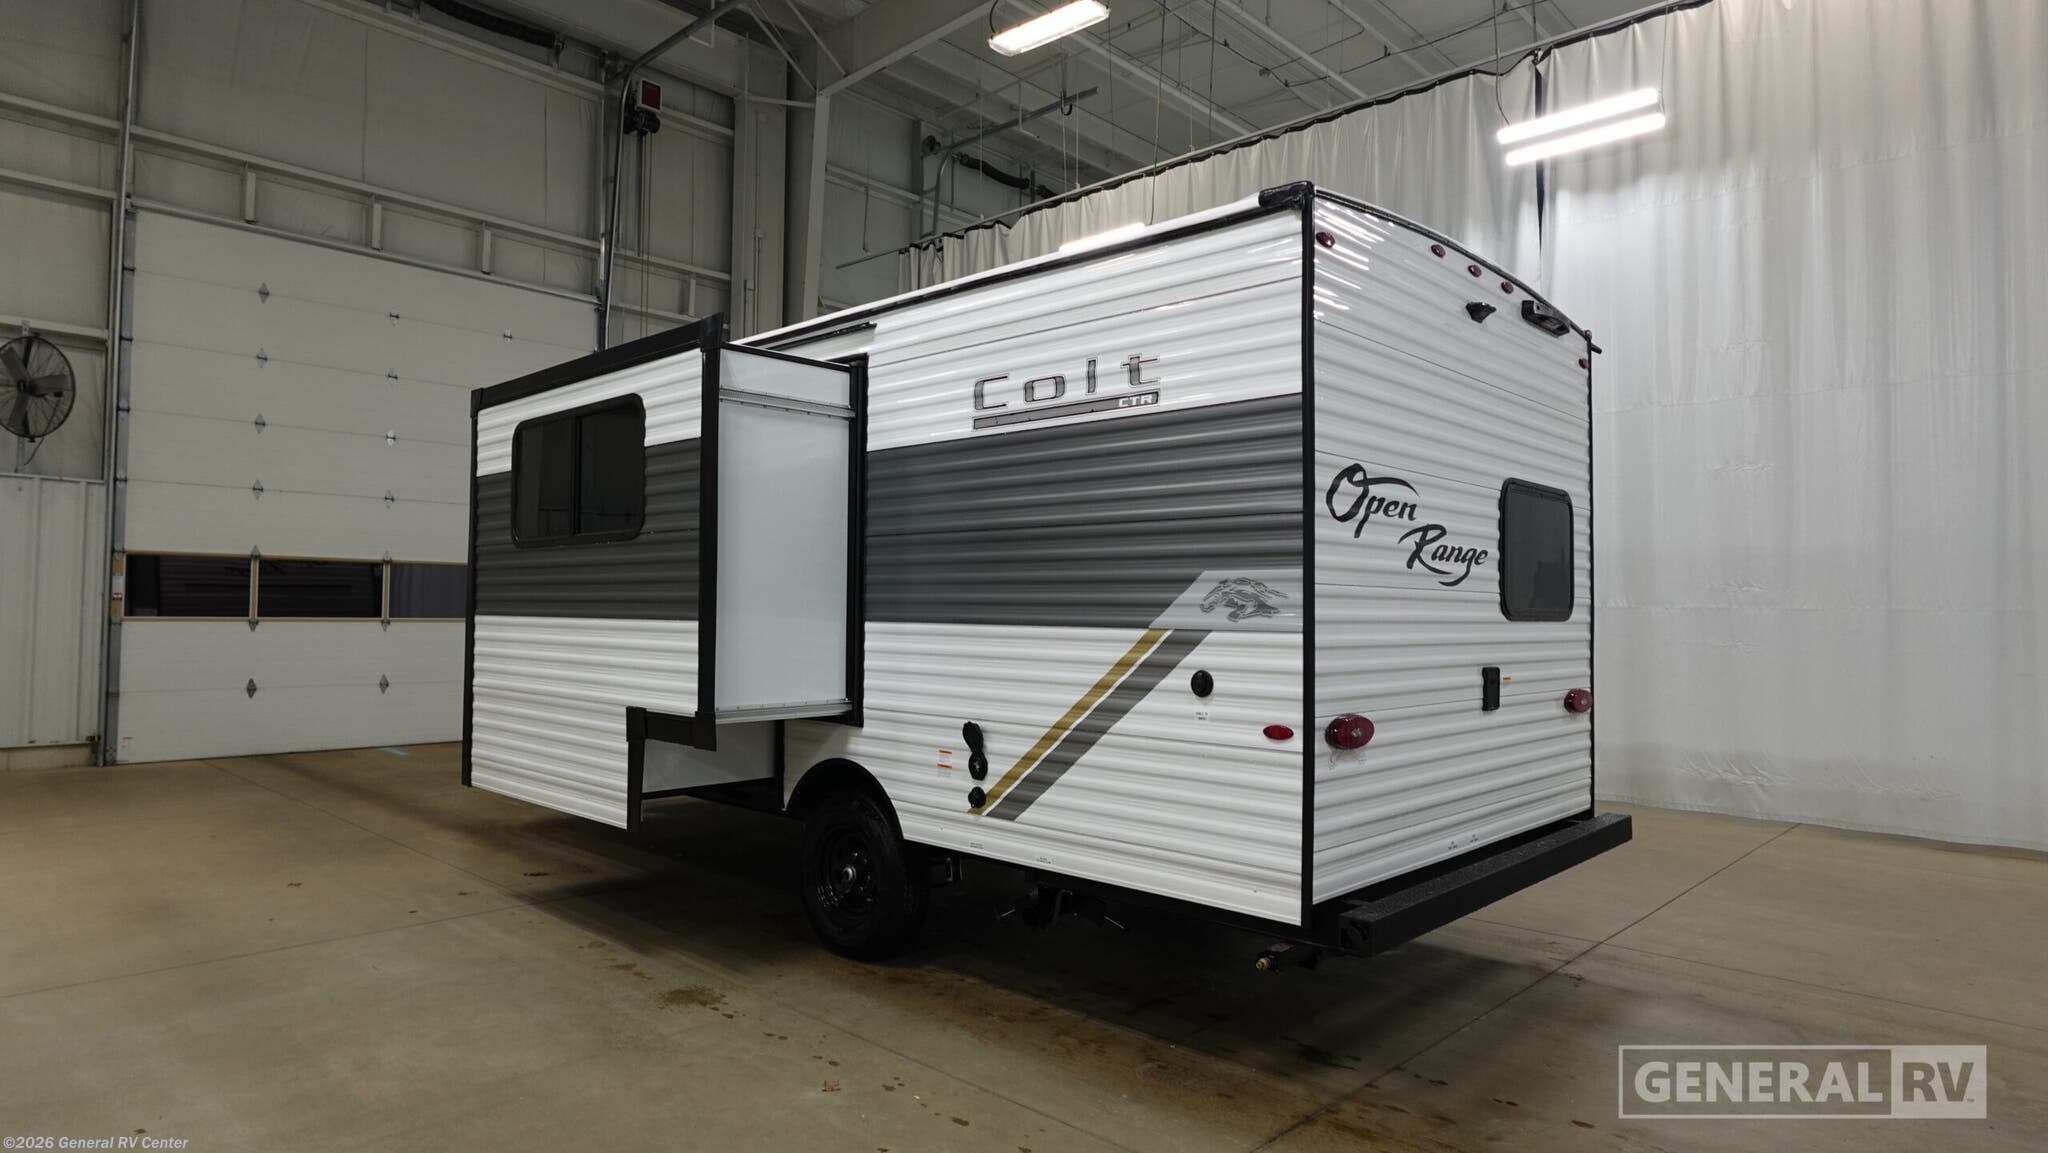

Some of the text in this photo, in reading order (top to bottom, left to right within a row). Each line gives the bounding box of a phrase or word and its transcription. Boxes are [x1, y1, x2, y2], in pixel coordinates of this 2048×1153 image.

[974, 355, 1160, 411] Colt
[1118, 394, 1153, 408] CTR
[1326, 463, 1419, 538] Open
[1397, 524, 1488, 587] Range
